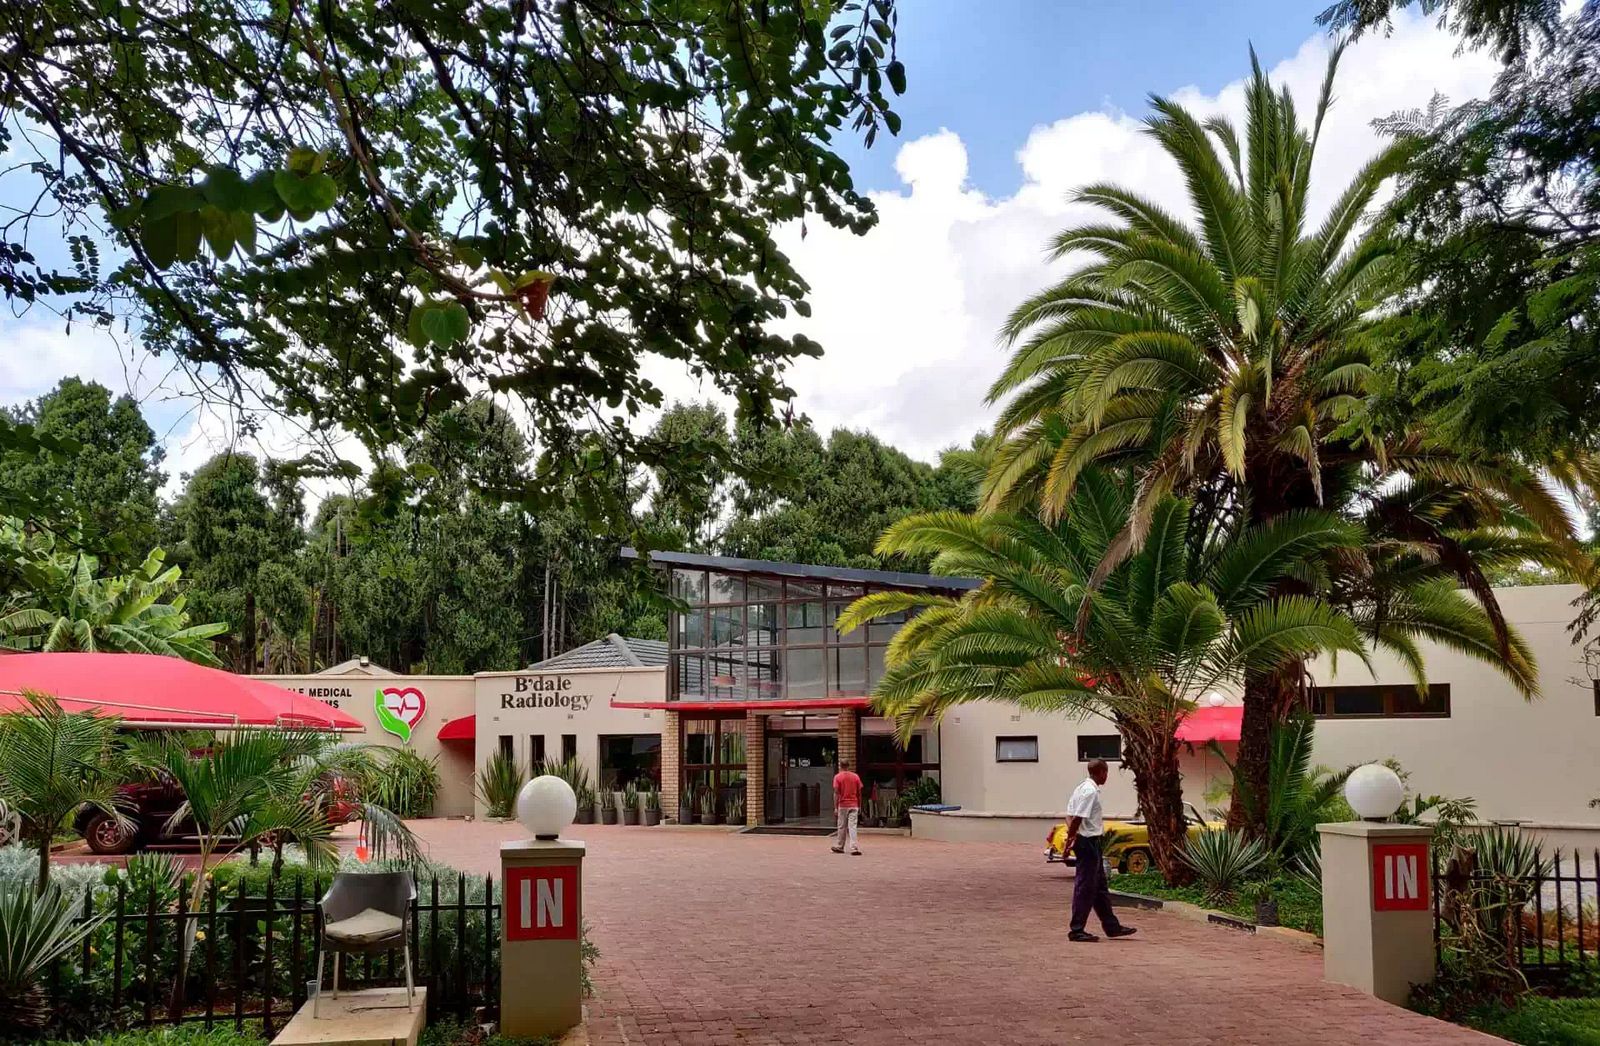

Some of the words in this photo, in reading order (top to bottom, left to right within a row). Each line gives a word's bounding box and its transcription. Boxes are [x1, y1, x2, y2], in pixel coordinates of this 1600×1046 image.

[308, 687, 352, 698] MEDICAL
[500, 692, 593, 711] Radiology
[1384, 855, 1418, 899] IN
[520, 878, 563, 928] IN
